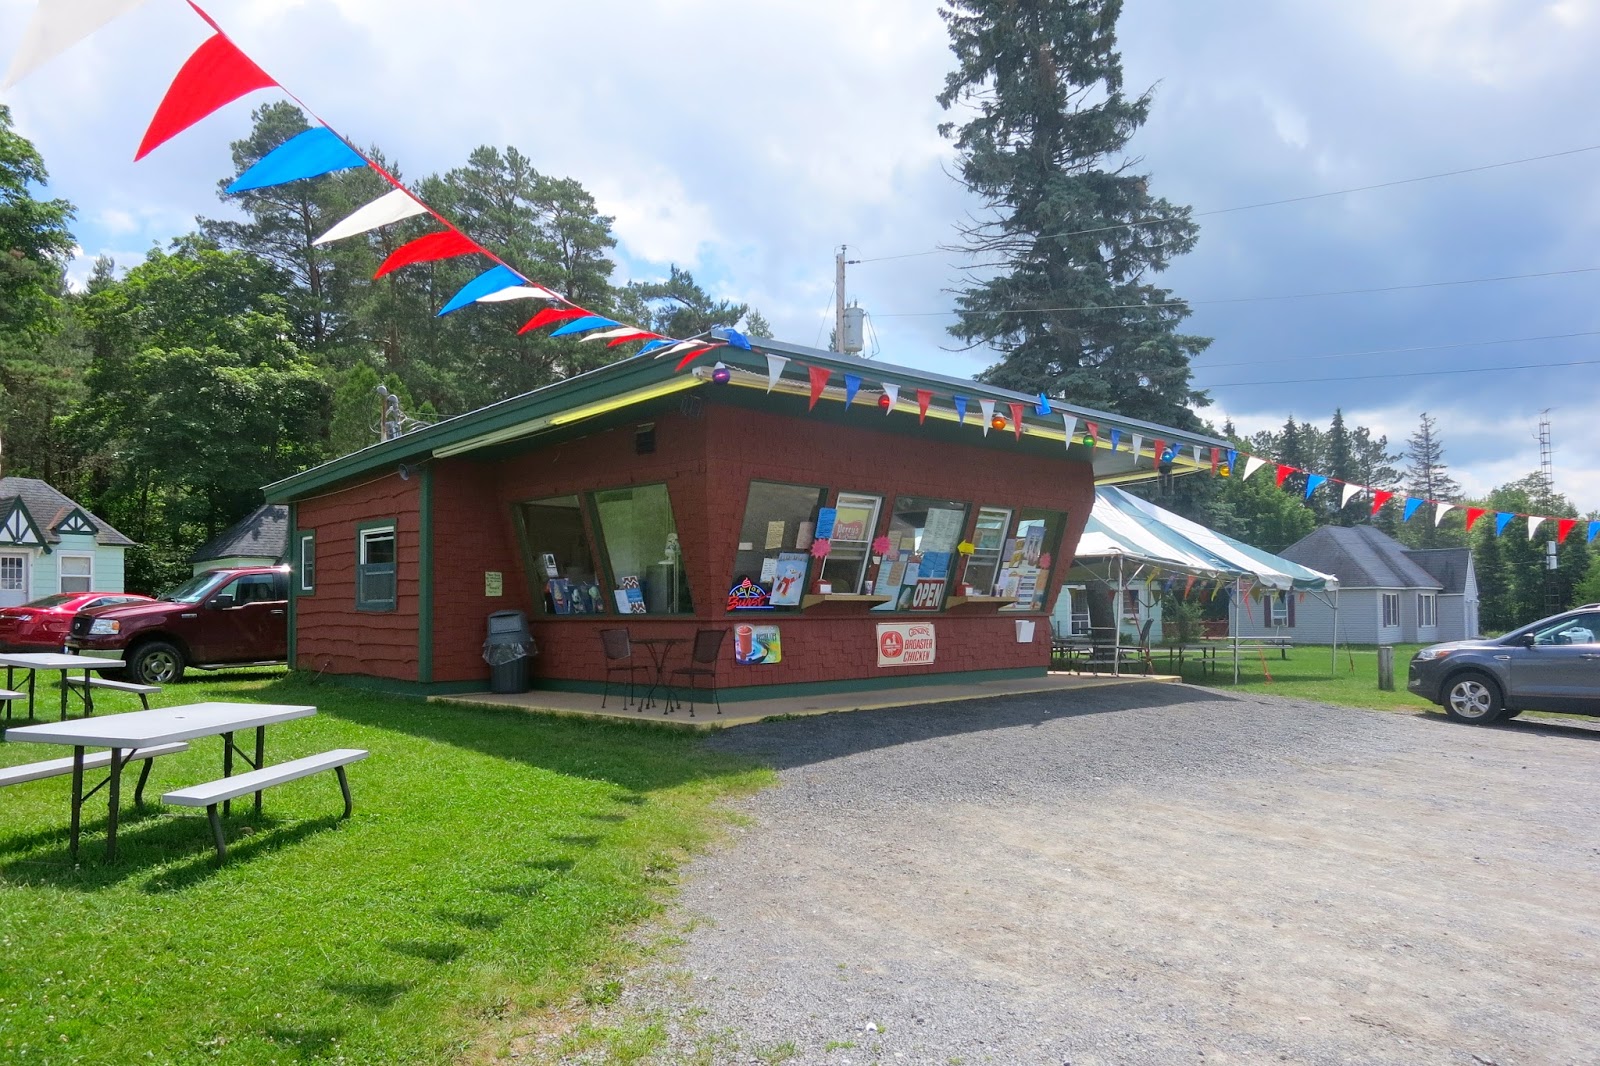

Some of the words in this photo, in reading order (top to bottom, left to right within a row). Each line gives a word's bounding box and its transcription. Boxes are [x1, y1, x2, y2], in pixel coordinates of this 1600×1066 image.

[836, 524, 859, 537] Perry's
[912, 582, 943, 607] OPEN
[727, 592, 769, 611] Burst
[904, 639, 933, 650] BROASTER
[903, 650, 930, 662] CHICKEN
